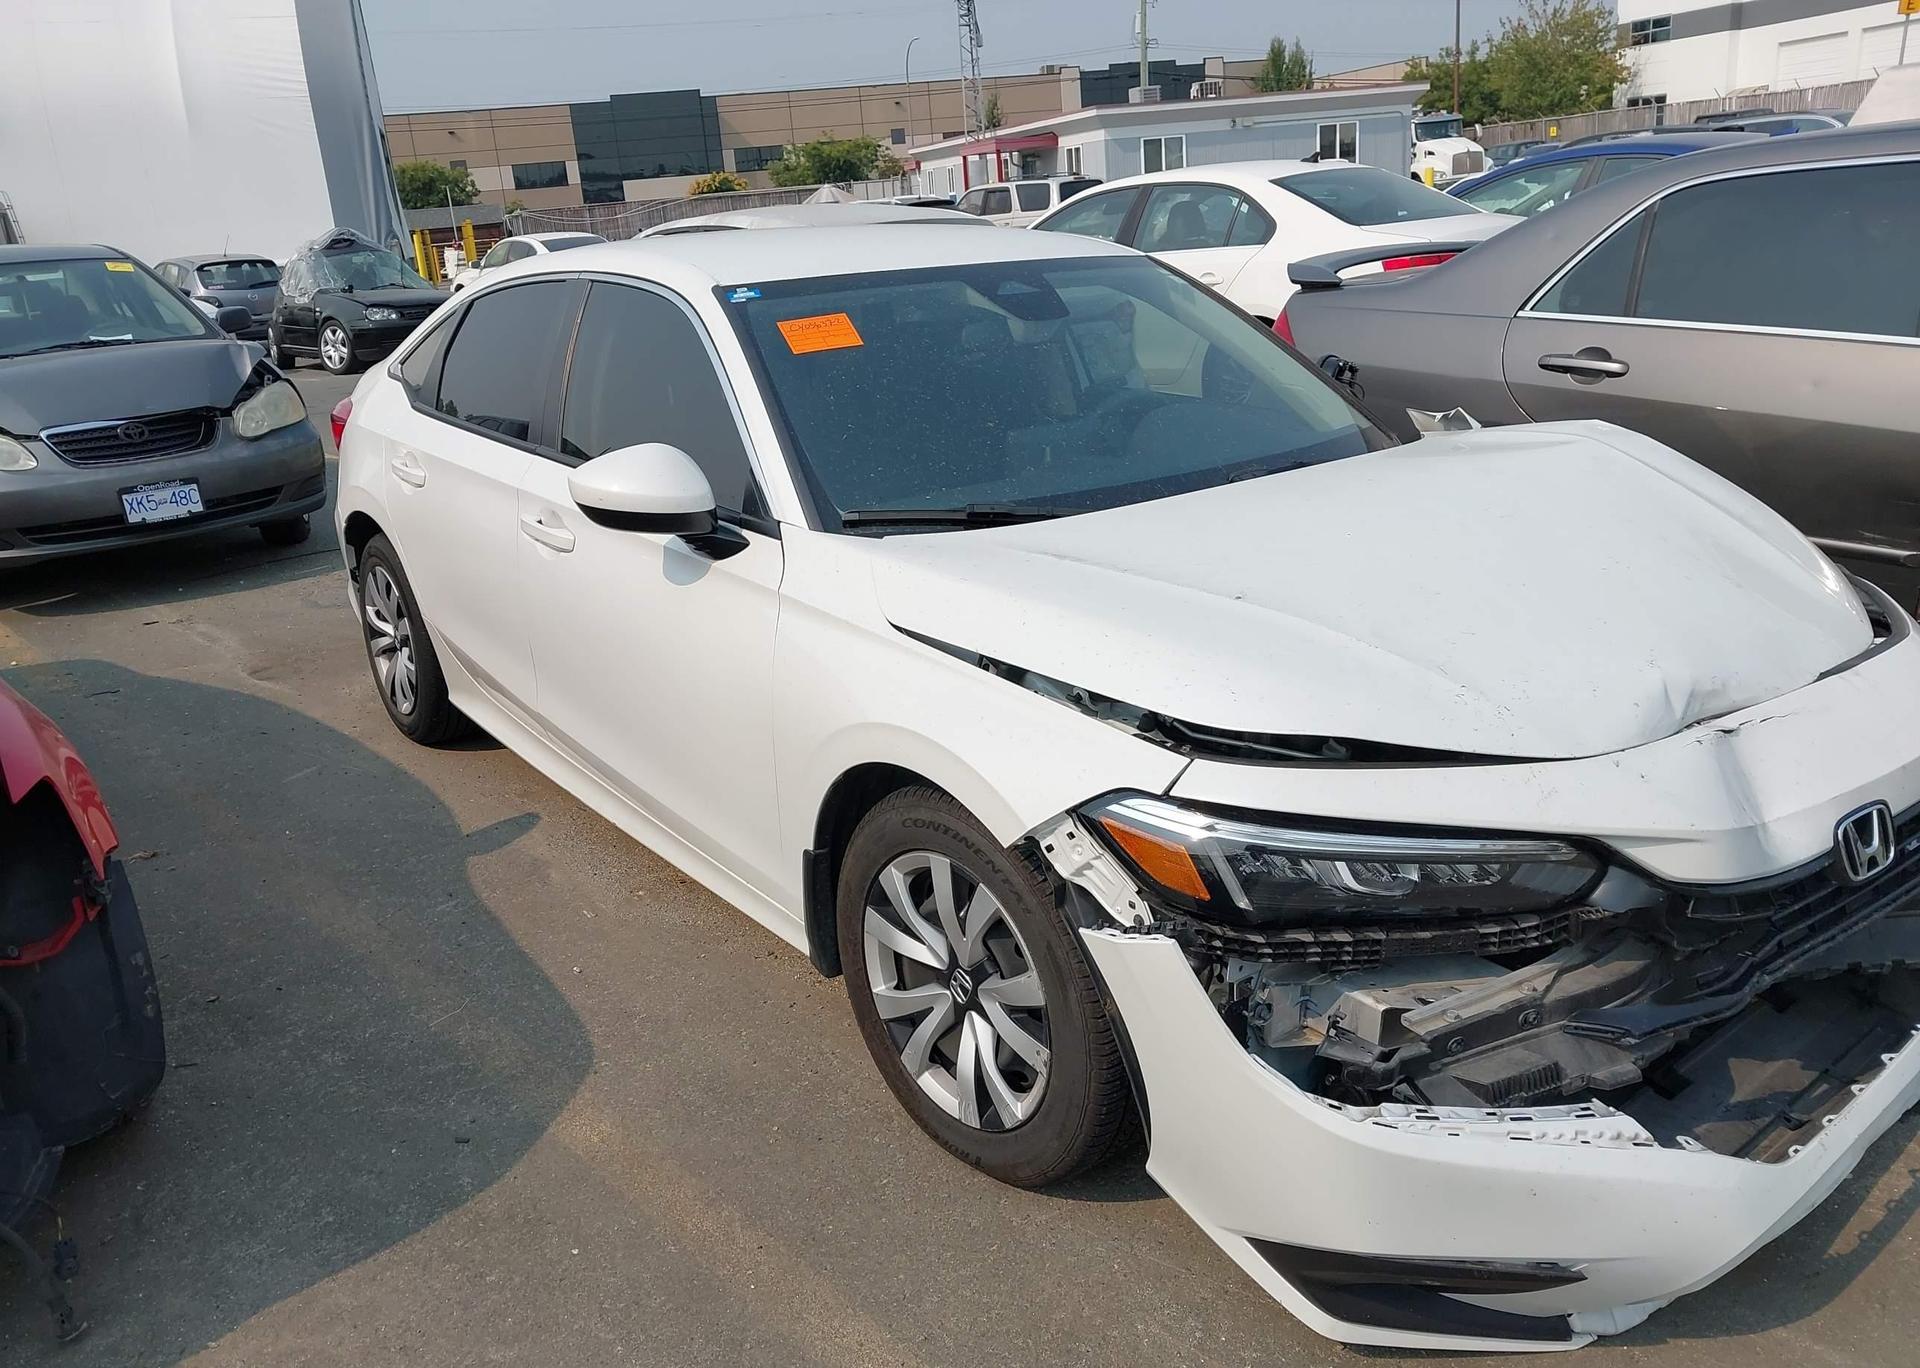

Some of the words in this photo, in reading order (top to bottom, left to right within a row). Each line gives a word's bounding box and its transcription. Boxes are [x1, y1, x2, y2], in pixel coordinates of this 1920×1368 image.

[137, 480, 180, 492] OpenRoad
[125, 494, 158, 516] XK5
[169, 488, 200, 507] 48C
